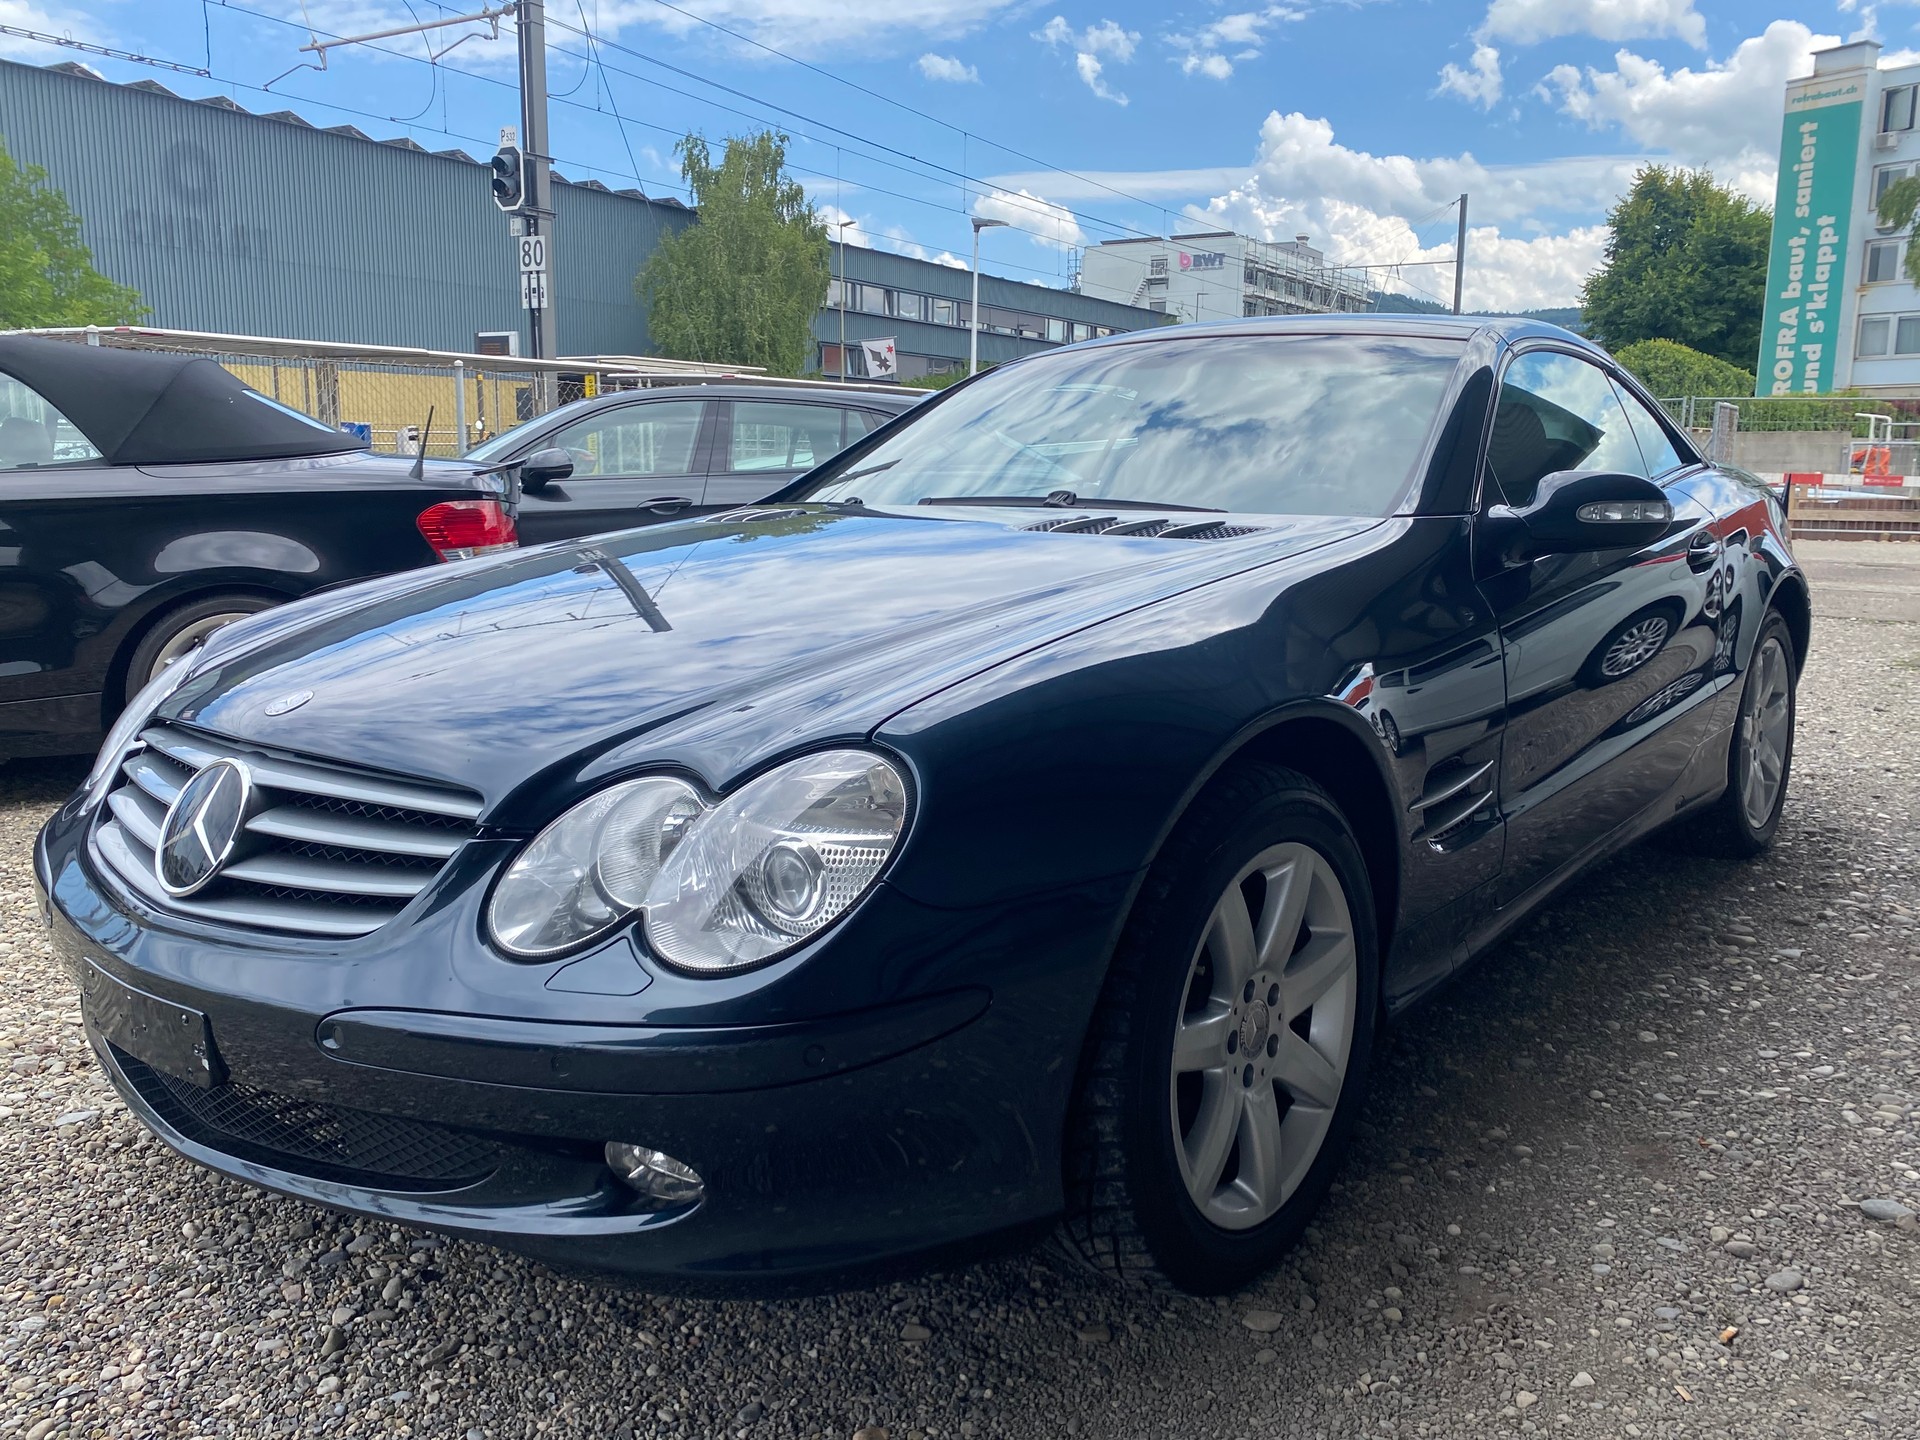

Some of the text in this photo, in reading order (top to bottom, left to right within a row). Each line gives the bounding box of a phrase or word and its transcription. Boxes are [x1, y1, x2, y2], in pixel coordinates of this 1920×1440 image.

[1791, 85, 1858, 104] rofrabaut.ch
[522, 239, 544, 268] 80
[1193, 253, 1226, 267] BWT
[1772, 122, 1819, 396] ROFRA baut, saniert
[1801, 343, 1823, 393] und
